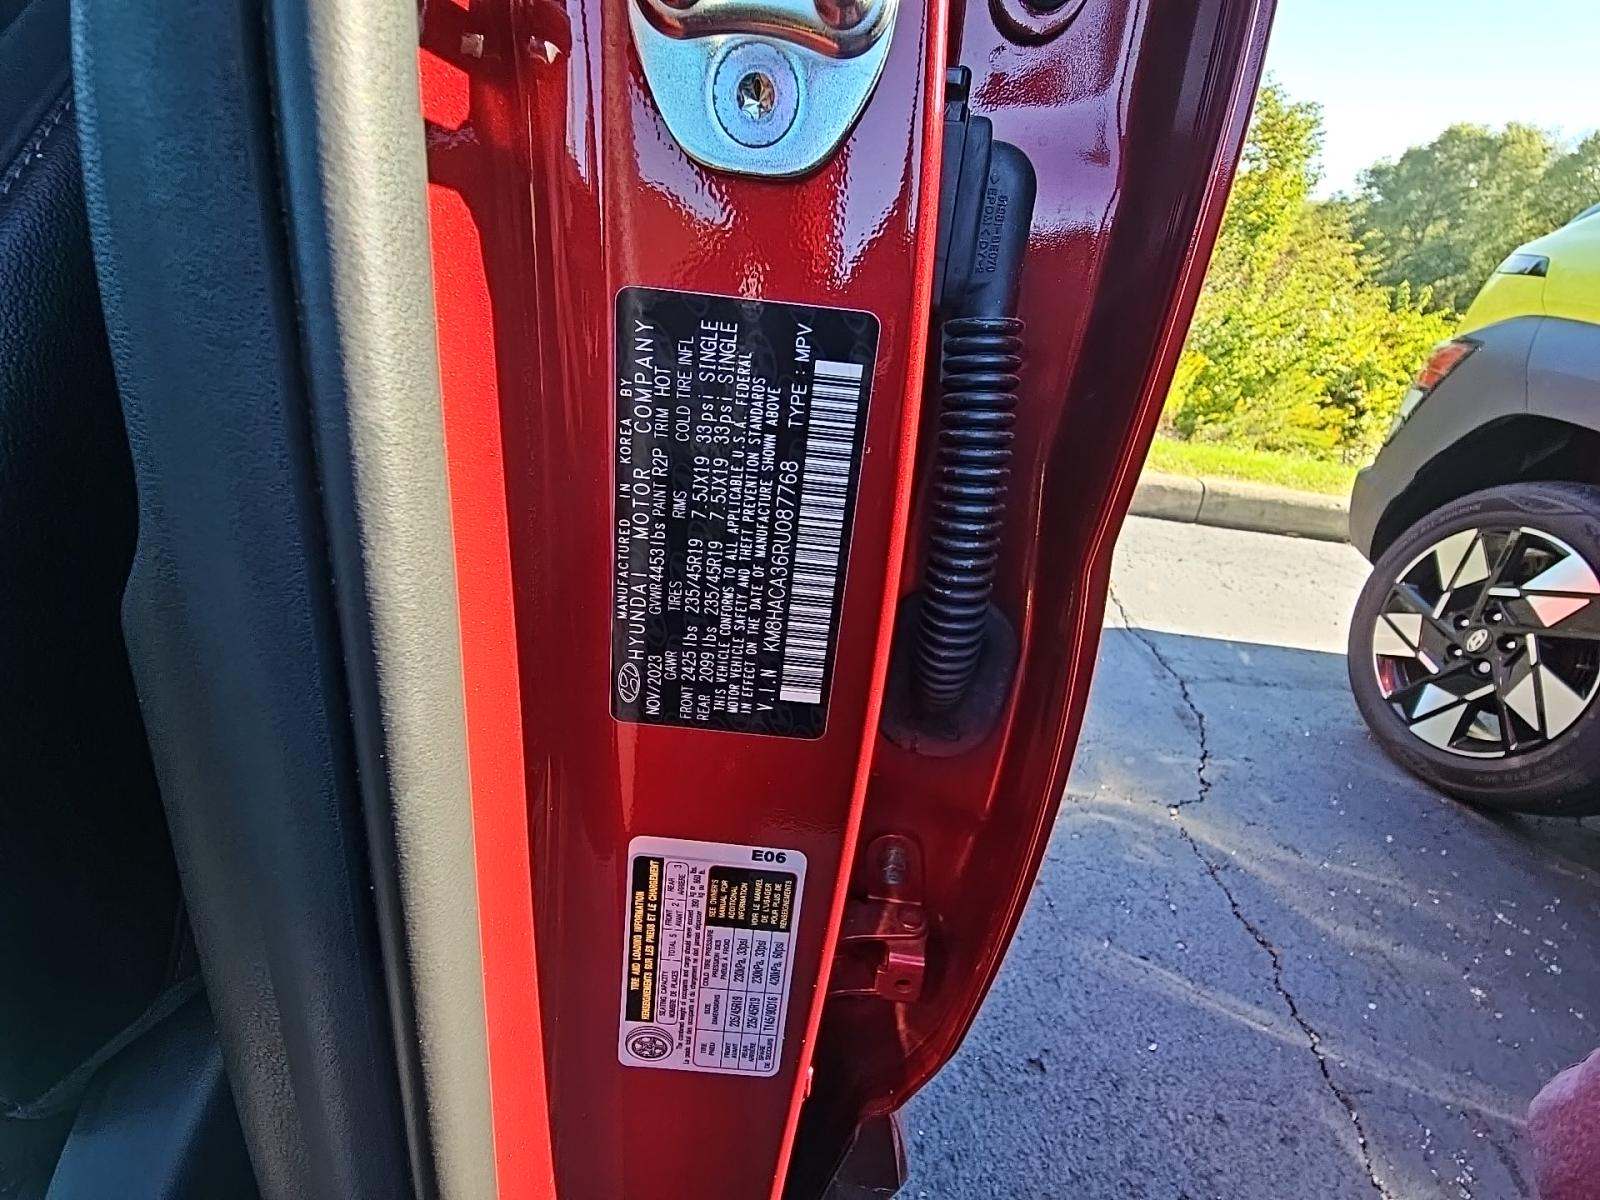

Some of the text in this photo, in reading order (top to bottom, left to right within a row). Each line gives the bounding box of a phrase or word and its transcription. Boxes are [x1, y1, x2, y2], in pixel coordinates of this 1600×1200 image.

[699, 320, 718, 382] SINGLE
[718, 322, 738, 384] SINGLE
[794, 323, 813, 362] MPV
[655, 366, 671, 396] HOT
[654, 408, 669, 438] TRIM
[788, 383, 807, 428] TYPE
[653, 448, 668, 476] R2P
[617, 378, 632, 619] MANUFACTURED IN KOREA BY
[629, 320, 653, 659] HYUNDAI MOTOR COMPANY
[652, 482, 666, 516] PAINT
[692, 456, 709, 518] 7.5JX19
[710, 458, 729, 520] 7.5JX19
[664, 336, 694, 680] GAWR TIRES RIMS COLD TIRE INFL
[714, 352, 752, 710] THIS VEHICLE CONFORMS TO ALL APPLICABLE U.S.A. FEDERAL
[727, 376, 766, 713] MOTOR VEHICLE SAFETY AND THEFT PREVENTION STANDARDS
[741, 387, 781, 713] IN EFFECT ON THE DATE OF MANUFACTURE SHOWN ABOVE
[763, 461, 798, 651] KM8HACA36RU087768
[686, 538, 703, 613] 235/45R19
[704, 541, 723, 615] 235/45R19
[684, 626, 698, 646] lbs
[701, 627, 717, 647] lbs
[682, 651, 697, 681] 2425
[700, 652, 714, 682] 2099
[646, 656, 661, 715] NOV/2023
[680, 686, 694, 719] FRONT
[697, 695, 710, 720] REAR
[752, 850, 786, 863] E06
[649, 860, 659, 900] CHARGEMENT
[708, 879, 719, 917] SEE OWNER'S
[647, 913, 656, 921] ET
[719, 895, 728, 918] MANUAL
[729, 886, 738, 919] ADDITIONAL
[739, 882, 748, 920] INFORMATION
[751, 913, 759, 926] VOIR
[761, 883, 772, 923] DE L'USAGER
[770, 883, 782, 925] POUR PLUS DE
[780, 880, 792, 929] RENSEIGNEMENTS
[631, 891, 644, 990] TIRE AND LOADING INFORMATION
[646, 924, 655, 942] PNEUS
[646, 946, 654, 956] LES
[668, 941, 676, 957] TOTAL
[644, 958, 652, 969] SUR
[642, 972, 652, 1020] RENSEIGNEMENTS
[729, 996, 743, 1027] 235/45R19
[747, 998, 760, 1028] 235/45R19
